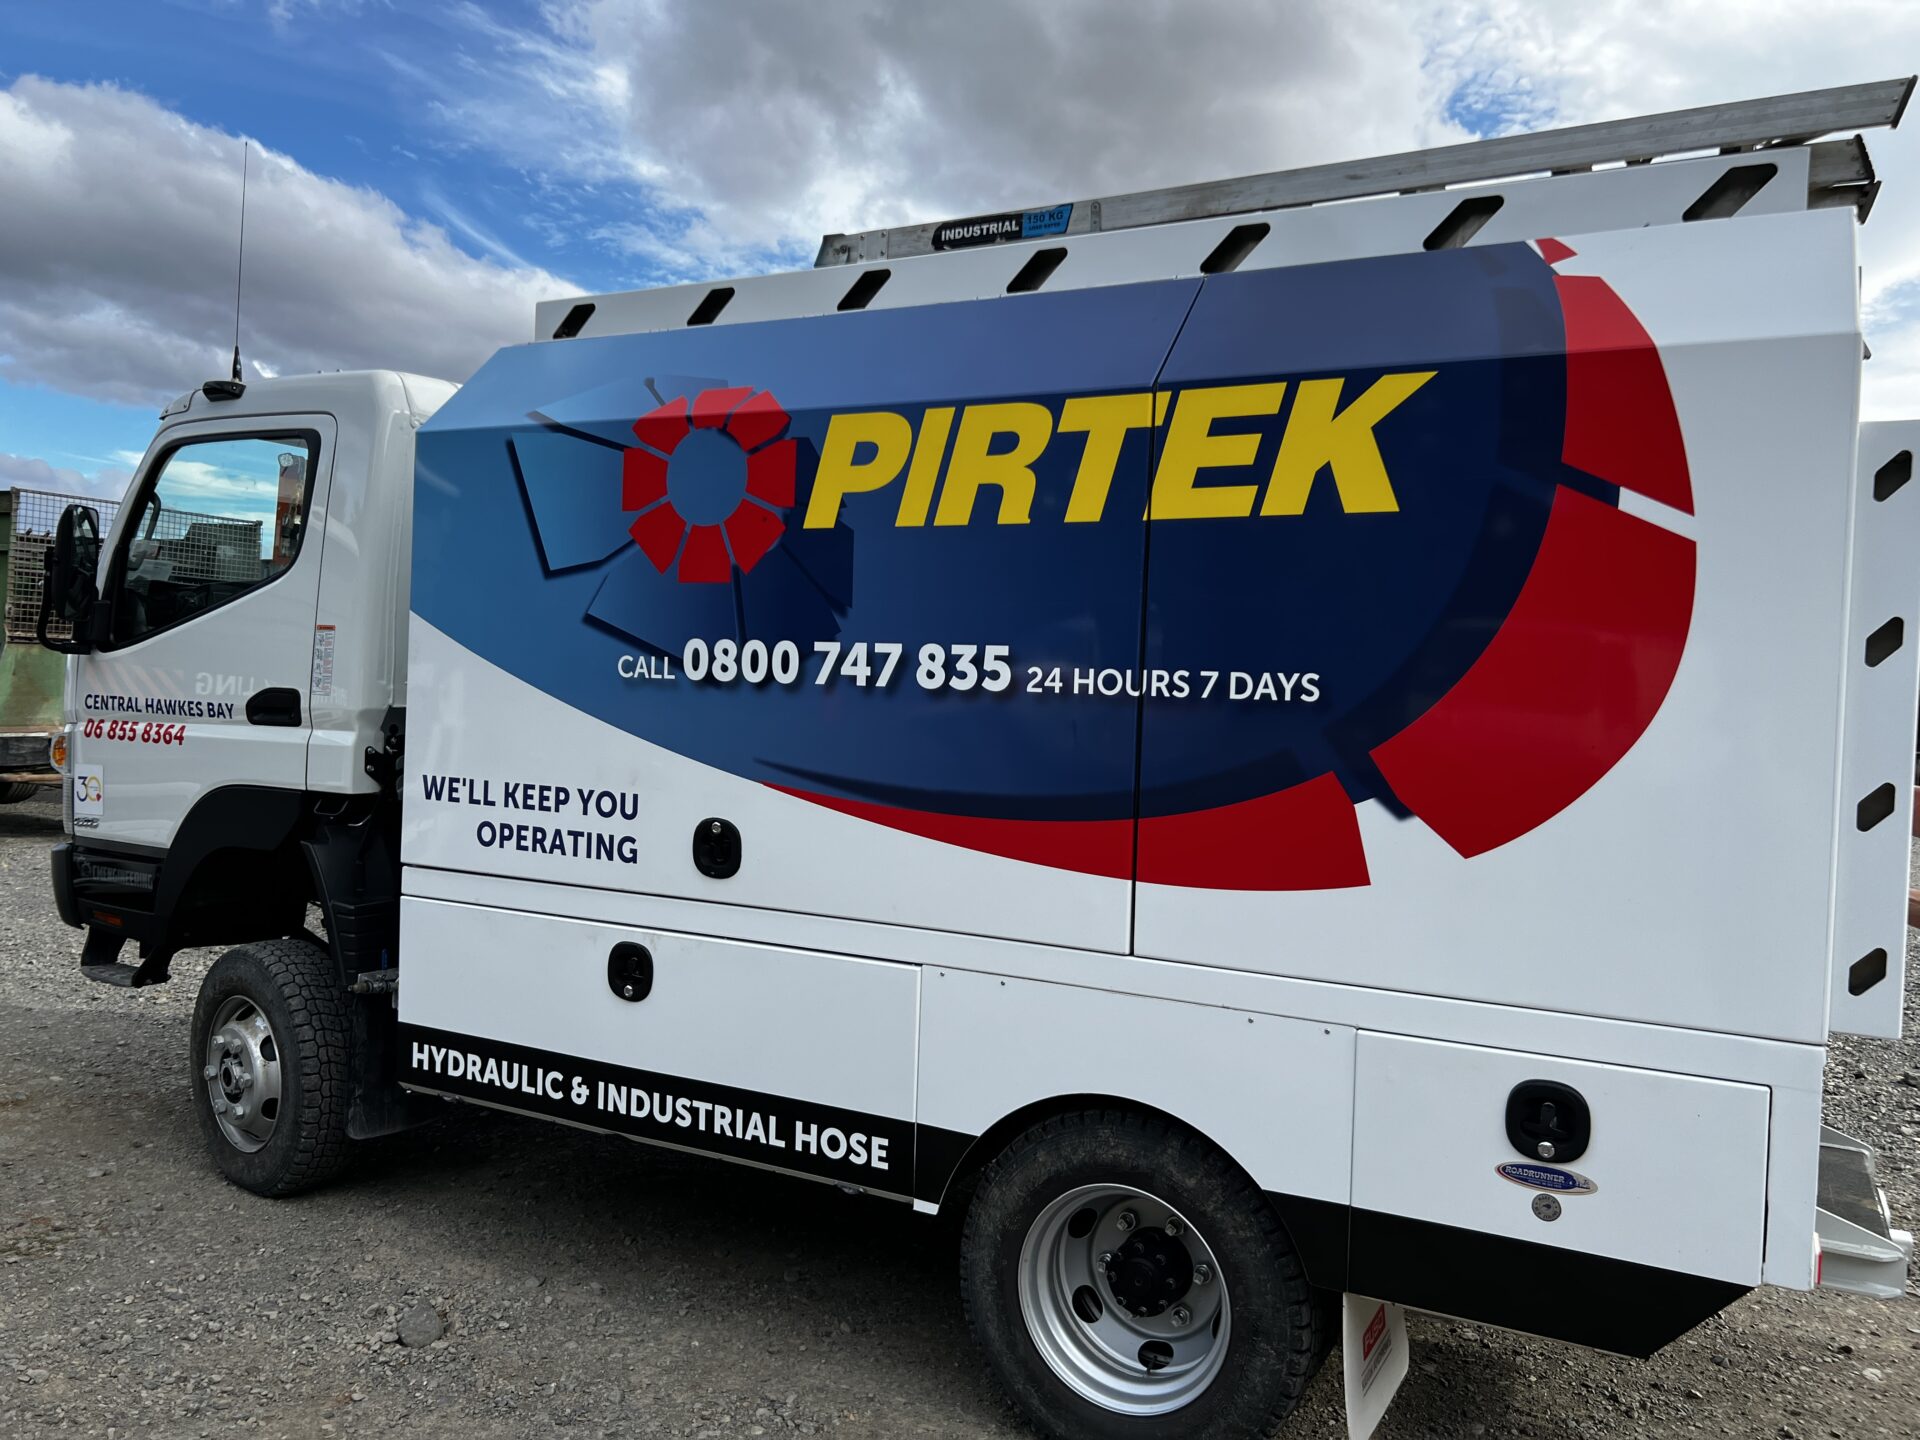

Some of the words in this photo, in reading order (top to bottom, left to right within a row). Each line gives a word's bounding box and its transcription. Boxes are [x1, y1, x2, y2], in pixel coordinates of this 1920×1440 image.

[941, 219, 1020, 242] INDUSTRIAL
[1027, 213, 1046, 224] 150
[1048, 211, 1064, 222] KG
[802, 370, 1440, 530] PIRTEK
[617, 654, 676, 681] CALL
[682, 637, 801, 685] 0800
[813, 641, 904, 688] 747
[915, 643, 1012, 692] 835
[1026, 666, 1063, 695] 24
[1073, 668, 1190, 699] HOURS
[1200, 670, 1217, 699] 7
[1228, 671, 1320, 703] DAYS
[85, 694, 142, 714] CENTRAL
[146, 698, 204, 718] HAWKES
[207, 702, 235, 719] BAY
[84, 718, 104, 739] 06
[107, 720, 137, 742] 855
[141, 722, 186, 746] 8364
[422, 774, 496, 807] WE'LL
[504, 782, 570, 813] KEEP
[577, 788, 639, 821] YOU
[476, 820, 638, 864] OPERATING
[412, 1042, 563, 1100] HYDRAULIC
[570, 1076, 590, 1105] &
[597, 1081, 785, 1149] INDUSTRIAL
[795, 1121, 889, 1170] HOSE
[1505, 1165, 1565, 1184] ROADRUNNER
